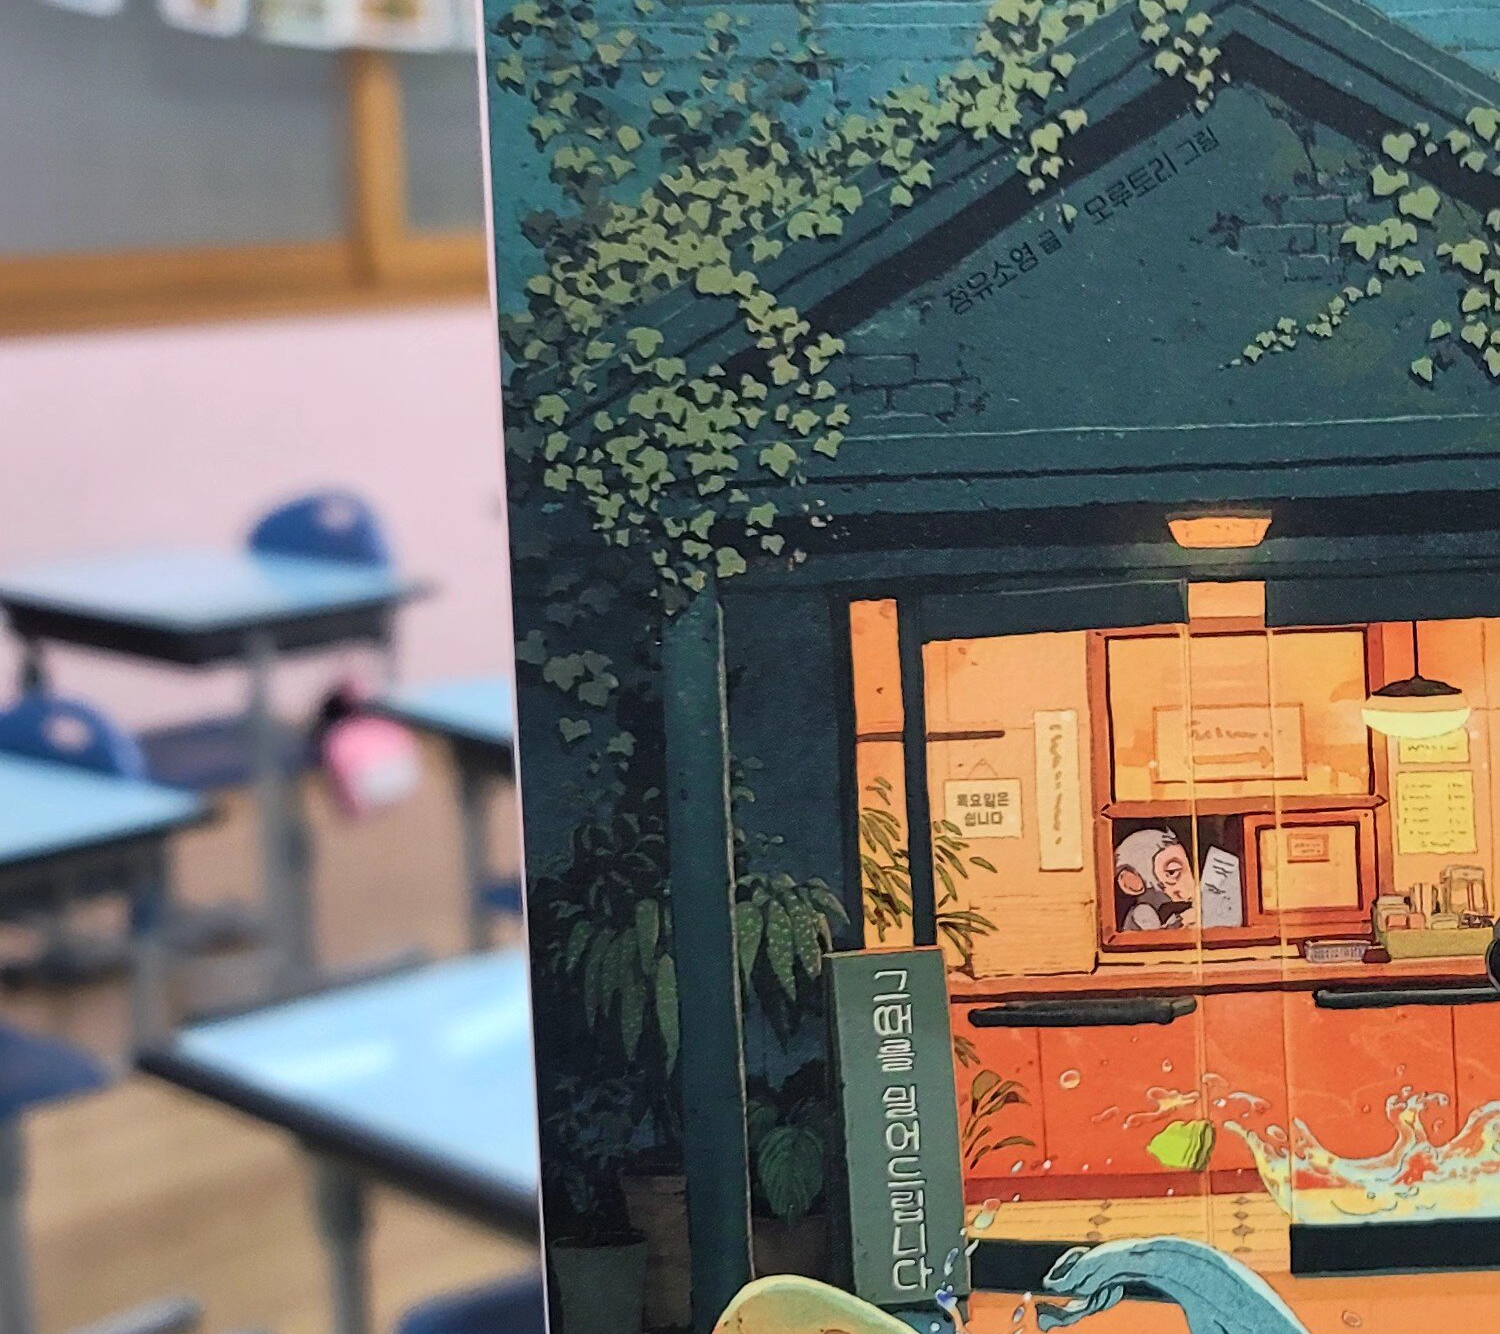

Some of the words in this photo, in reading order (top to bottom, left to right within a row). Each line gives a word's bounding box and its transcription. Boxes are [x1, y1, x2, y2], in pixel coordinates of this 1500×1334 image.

[943, 241, 1039, 315] 정유소영
[1038, 229, 1063, 255] 글
[1084, 154, 1178, 225] 모루토리
[1176, 126, 1221, 166] 그림
[965, 811, 1004, 827] 쉽니다
[873, 970, 915, 1072] 그때를
[882, 1084, 933, 1291] 밀어드립니다
